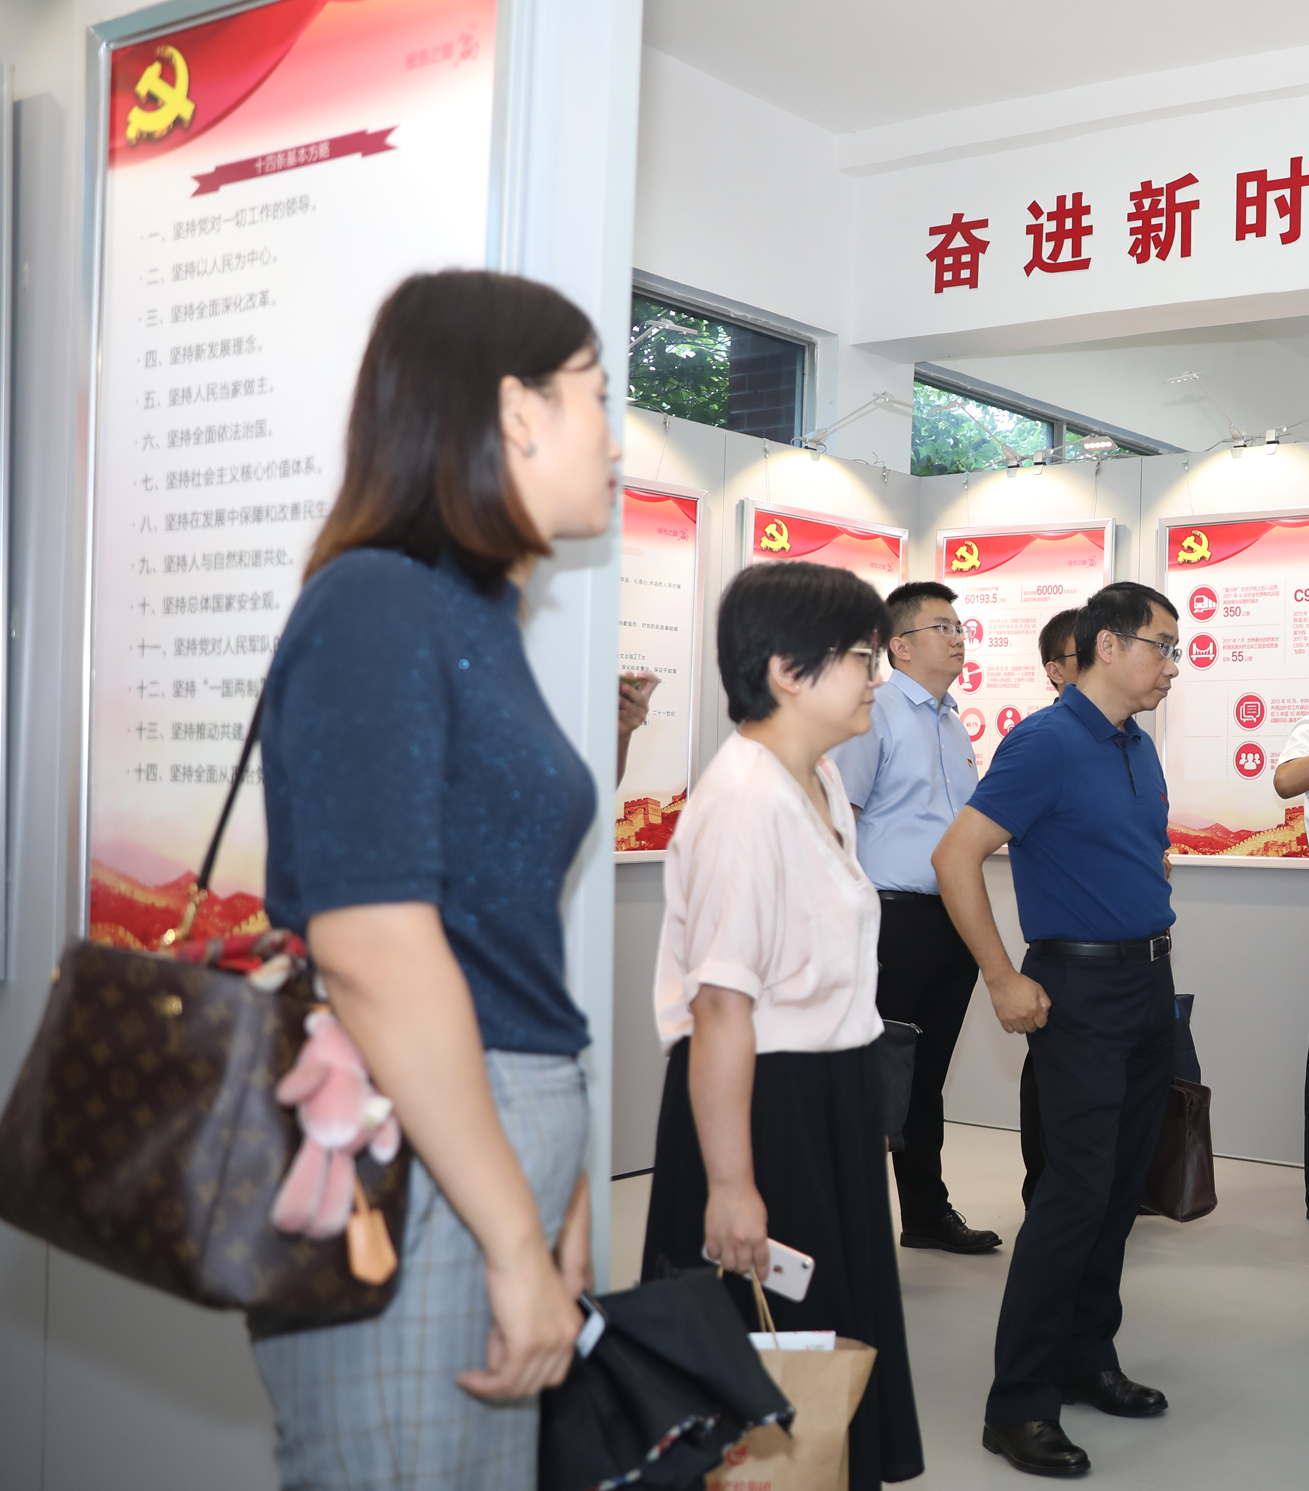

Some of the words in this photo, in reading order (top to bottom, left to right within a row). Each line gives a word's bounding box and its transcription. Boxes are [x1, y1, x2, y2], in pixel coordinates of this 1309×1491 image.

[255, 141, 330, 175] 十四条基本方略
[148, 194, 316, 242] 一、坚持党对一切工作的领导。
[147, 246, 277, 286] 二、坚持以人民为中心。
[146, 289, 276, 327] 三、坚持全面深化改革。
[144, 334, 263, 370] 四、坚持新发展理念。
[143, 376, 274, 411] 五、坚持人民当家做主。
[142, 419, 273, 451] 六、坚持全面依法治国。
[141, 456, 322, 493] 七、坚持社会主义核心价值体系。
[138, 591, 280, 616] 十、坚持总体国家安全观。
[964, 594, 998, 604] 60193.5
[1037, 584, 1063, 596] 60000
[1223, 606, 1241, 617] 350
[988, 637, 1009, 647] 3339
[1231, 651, 1244, 662] 55
